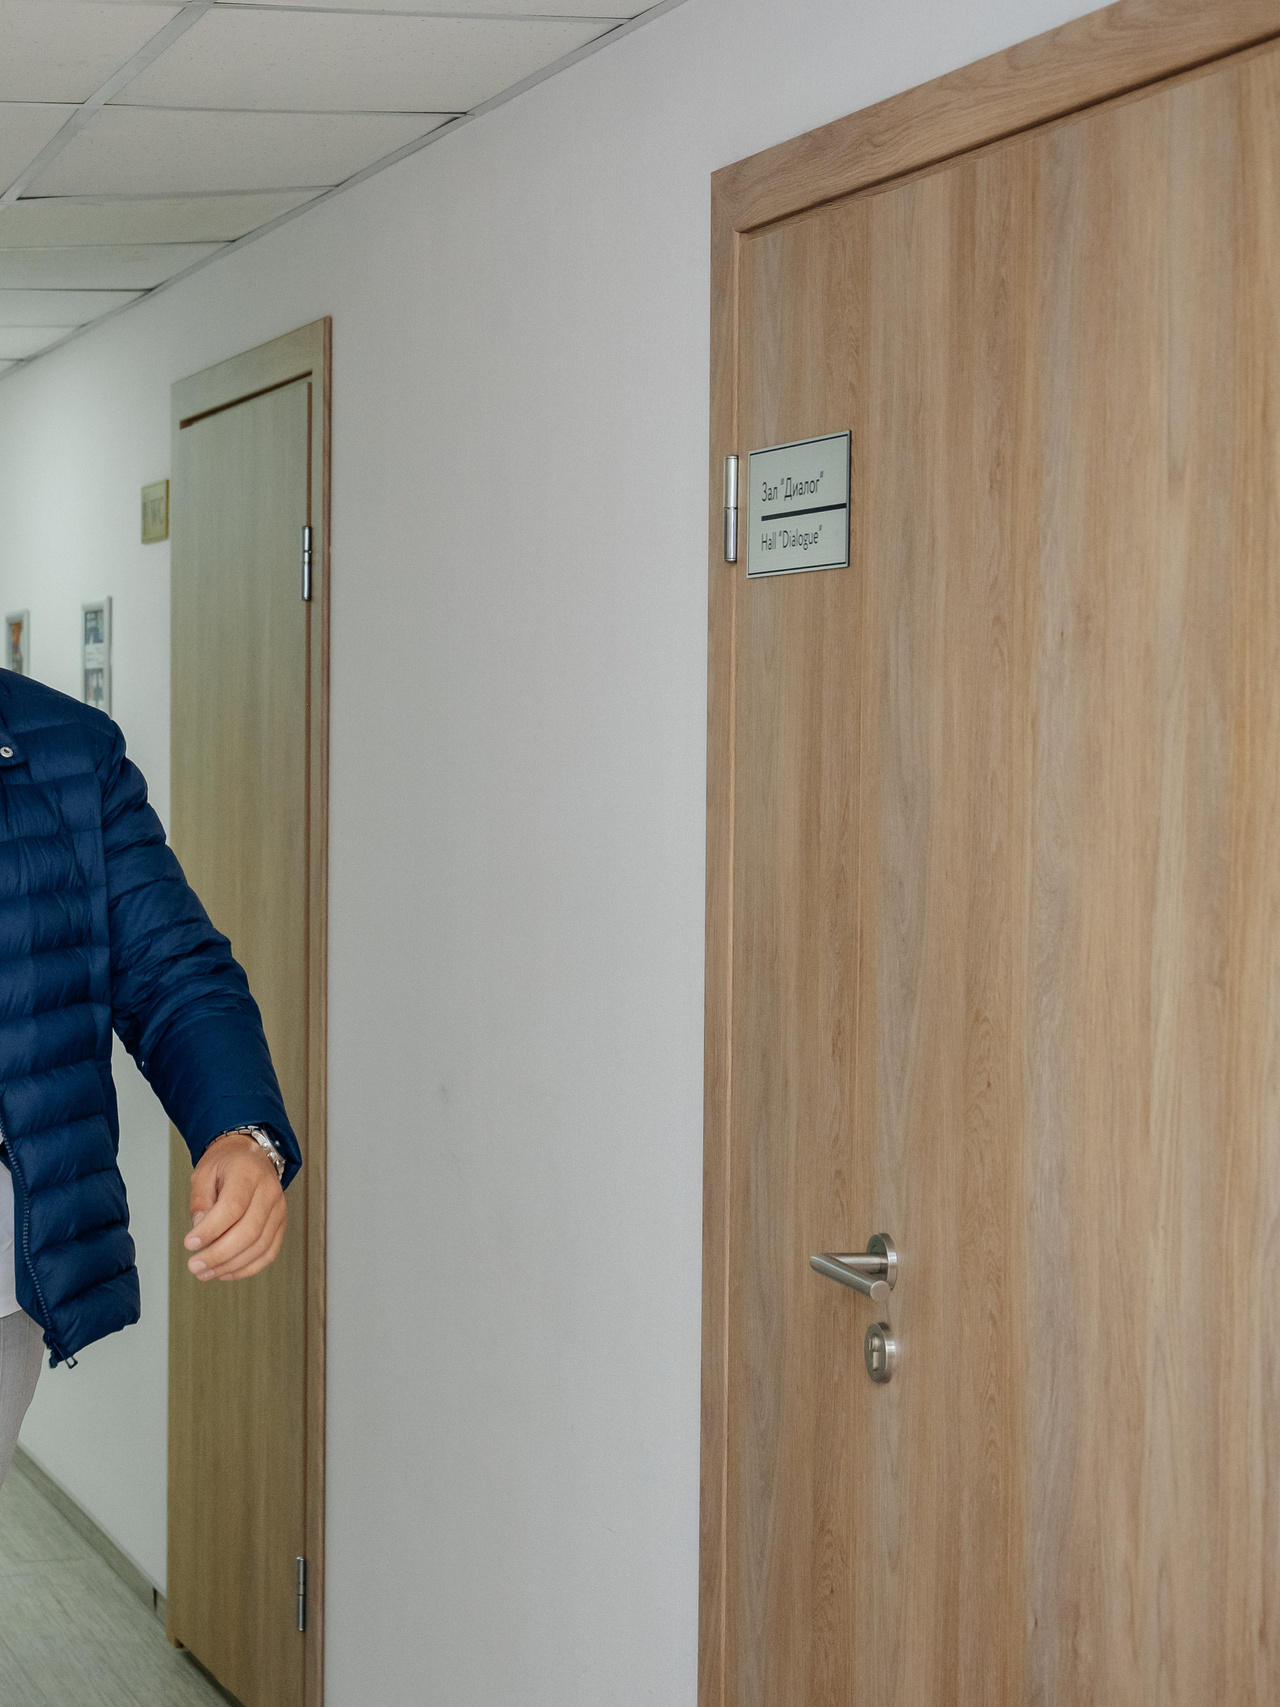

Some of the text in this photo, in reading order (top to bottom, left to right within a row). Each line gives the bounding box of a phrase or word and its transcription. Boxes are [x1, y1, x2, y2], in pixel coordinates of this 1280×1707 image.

[761, 471, 824, 502] Зал "Диалог"
[761, 525, 822, 551] Hall "Dialogue"
